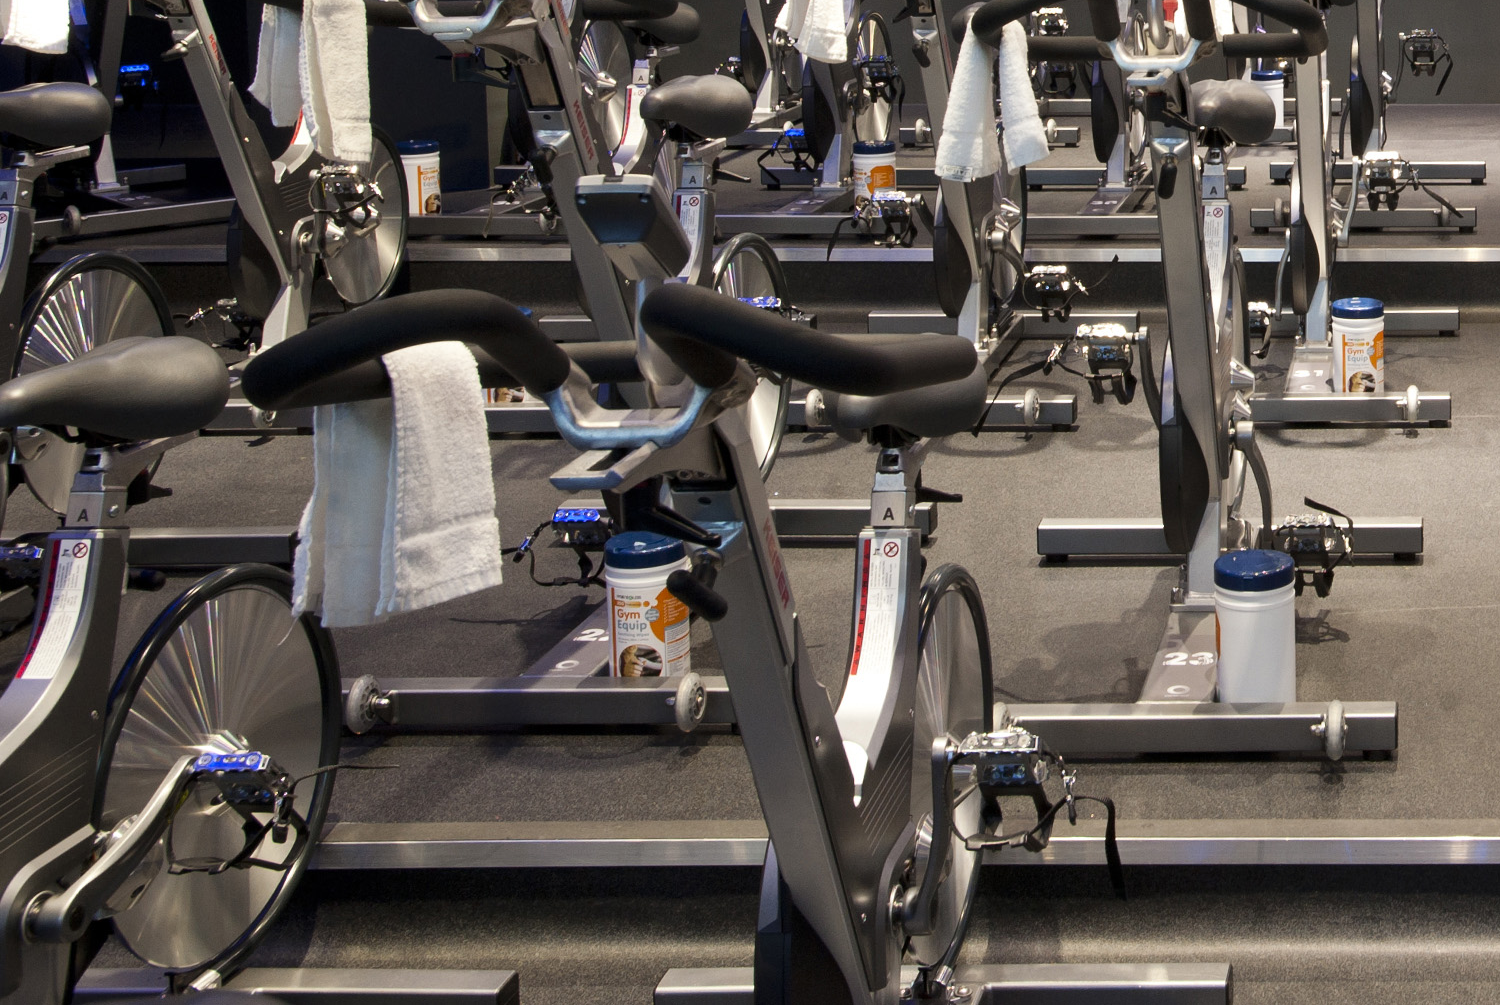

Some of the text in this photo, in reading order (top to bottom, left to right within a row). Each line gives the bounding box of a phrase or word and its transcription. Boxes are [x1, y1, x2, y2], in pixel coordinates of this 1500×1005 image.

[572, 99, 595, 160] KEISER
[688, 175, 697, 185] A
[1209, 186, 1218, 195] A
[1347, 348, 1364, 356] Gym
[1347, 355, 1368, 363] Equip
[77, 508, 89, 522] A
[883, 507, 895, 521] A
[763, 517, 790, 610] KEISER
[617, 608, 641, 621] Gym
[617, 620, 647, 632] Equip
[1162, 651, 1214, 666] 23
